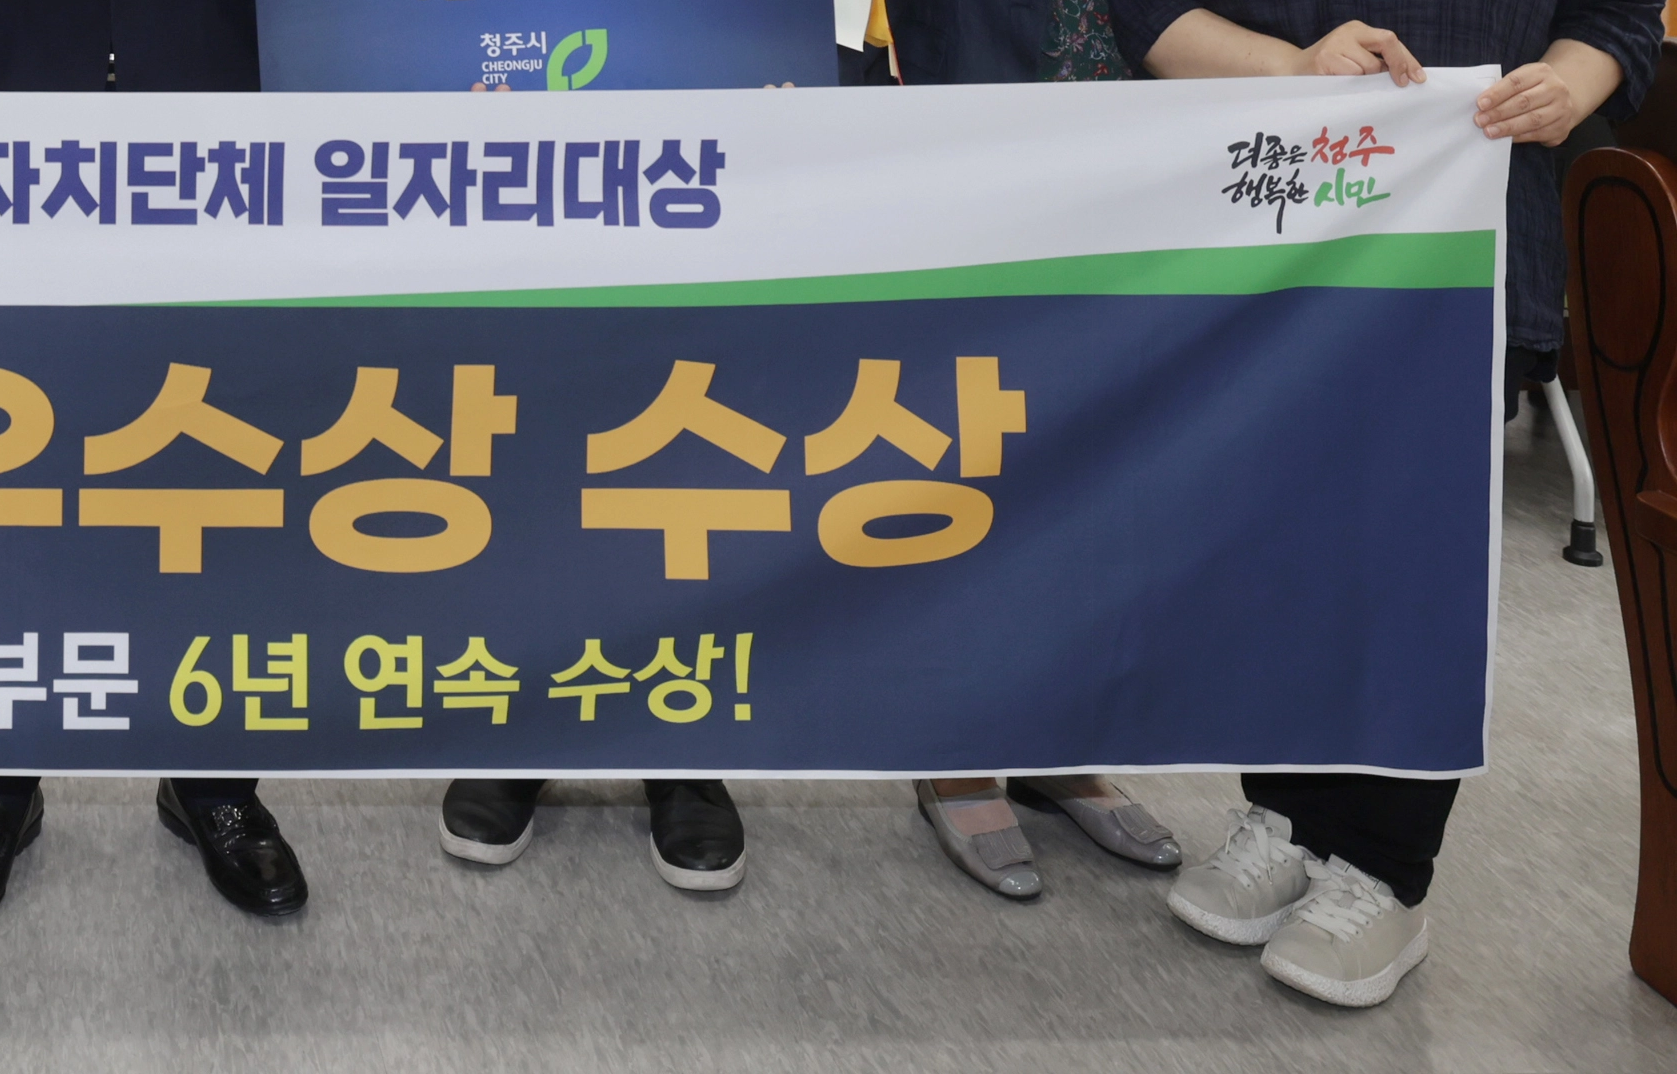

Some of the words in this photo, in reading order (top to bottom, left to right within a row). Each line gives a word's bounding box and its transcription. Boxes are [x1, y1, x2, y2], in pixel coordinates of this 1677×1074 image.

[480, 31, 547, 57] 청주시
[482, 59, 542, 72] CHEONGJU
[483, 73, 508, 84] CITY
[1311, 126, 1395, 167] 청주
[316, 141, 725, 228] 일자리대상
[1222, 168, 1309, 234] 행복한
[1314, 167, 1391, 208] 시민
[582, 357, 1026, 580] 수상
[171, 635, 310, 730] 6년
[344, 635, 520, 729] 연속
[549, 633, 753, 723] 수상!
